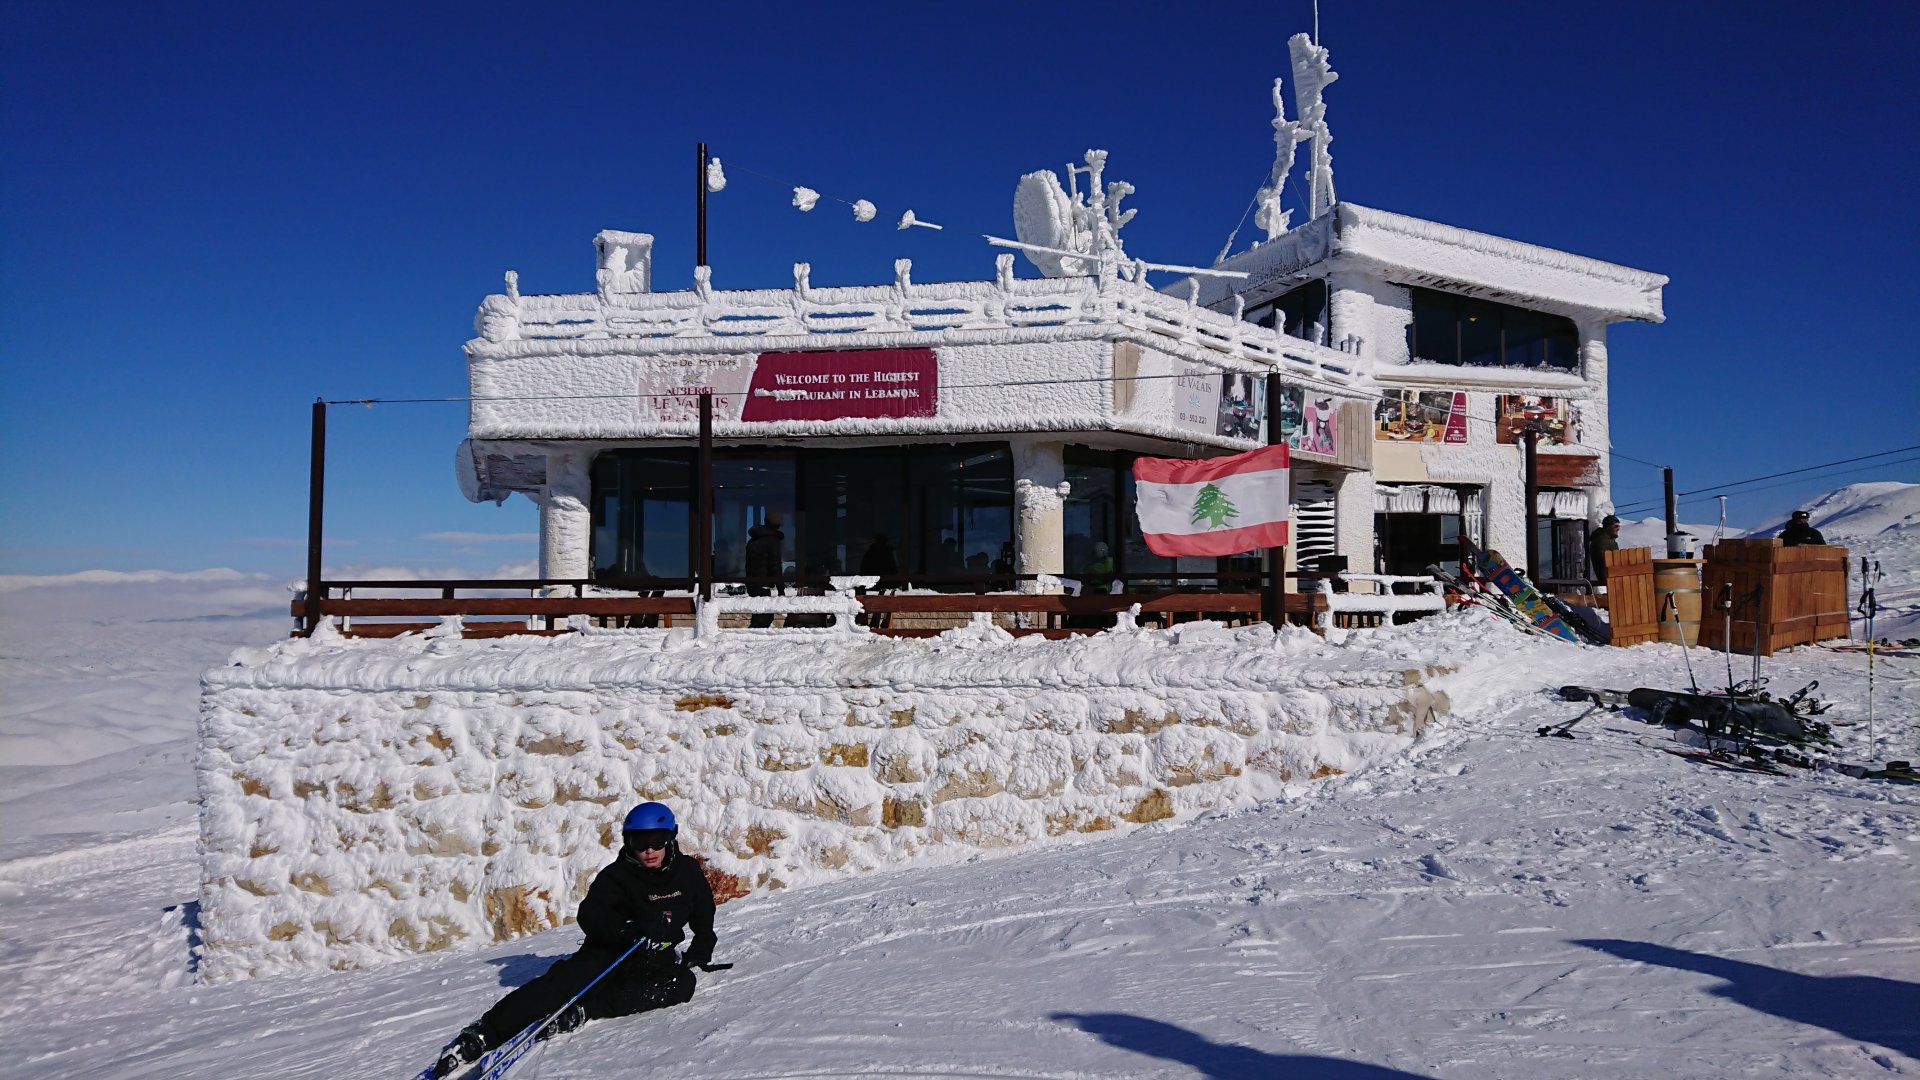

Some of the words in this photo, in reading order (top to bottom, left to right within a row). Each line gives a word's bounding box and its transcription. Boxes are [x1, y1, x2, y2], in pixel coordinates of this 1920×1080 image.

[775, 373, 830, 386] WELCOME
[832, 373, 846, 384] TO
[849, 373, 870, 383] THE
[873, 371, 920, 383] HIGHEST
[1177, 375, 1186, 388] LE
[1187, 377, 1212, 394] VALAIS
[849, 390, 861, 399] IN
[864, 388, 920, 400] LEBANON.
[675, 396, 729, 409] VALIS
